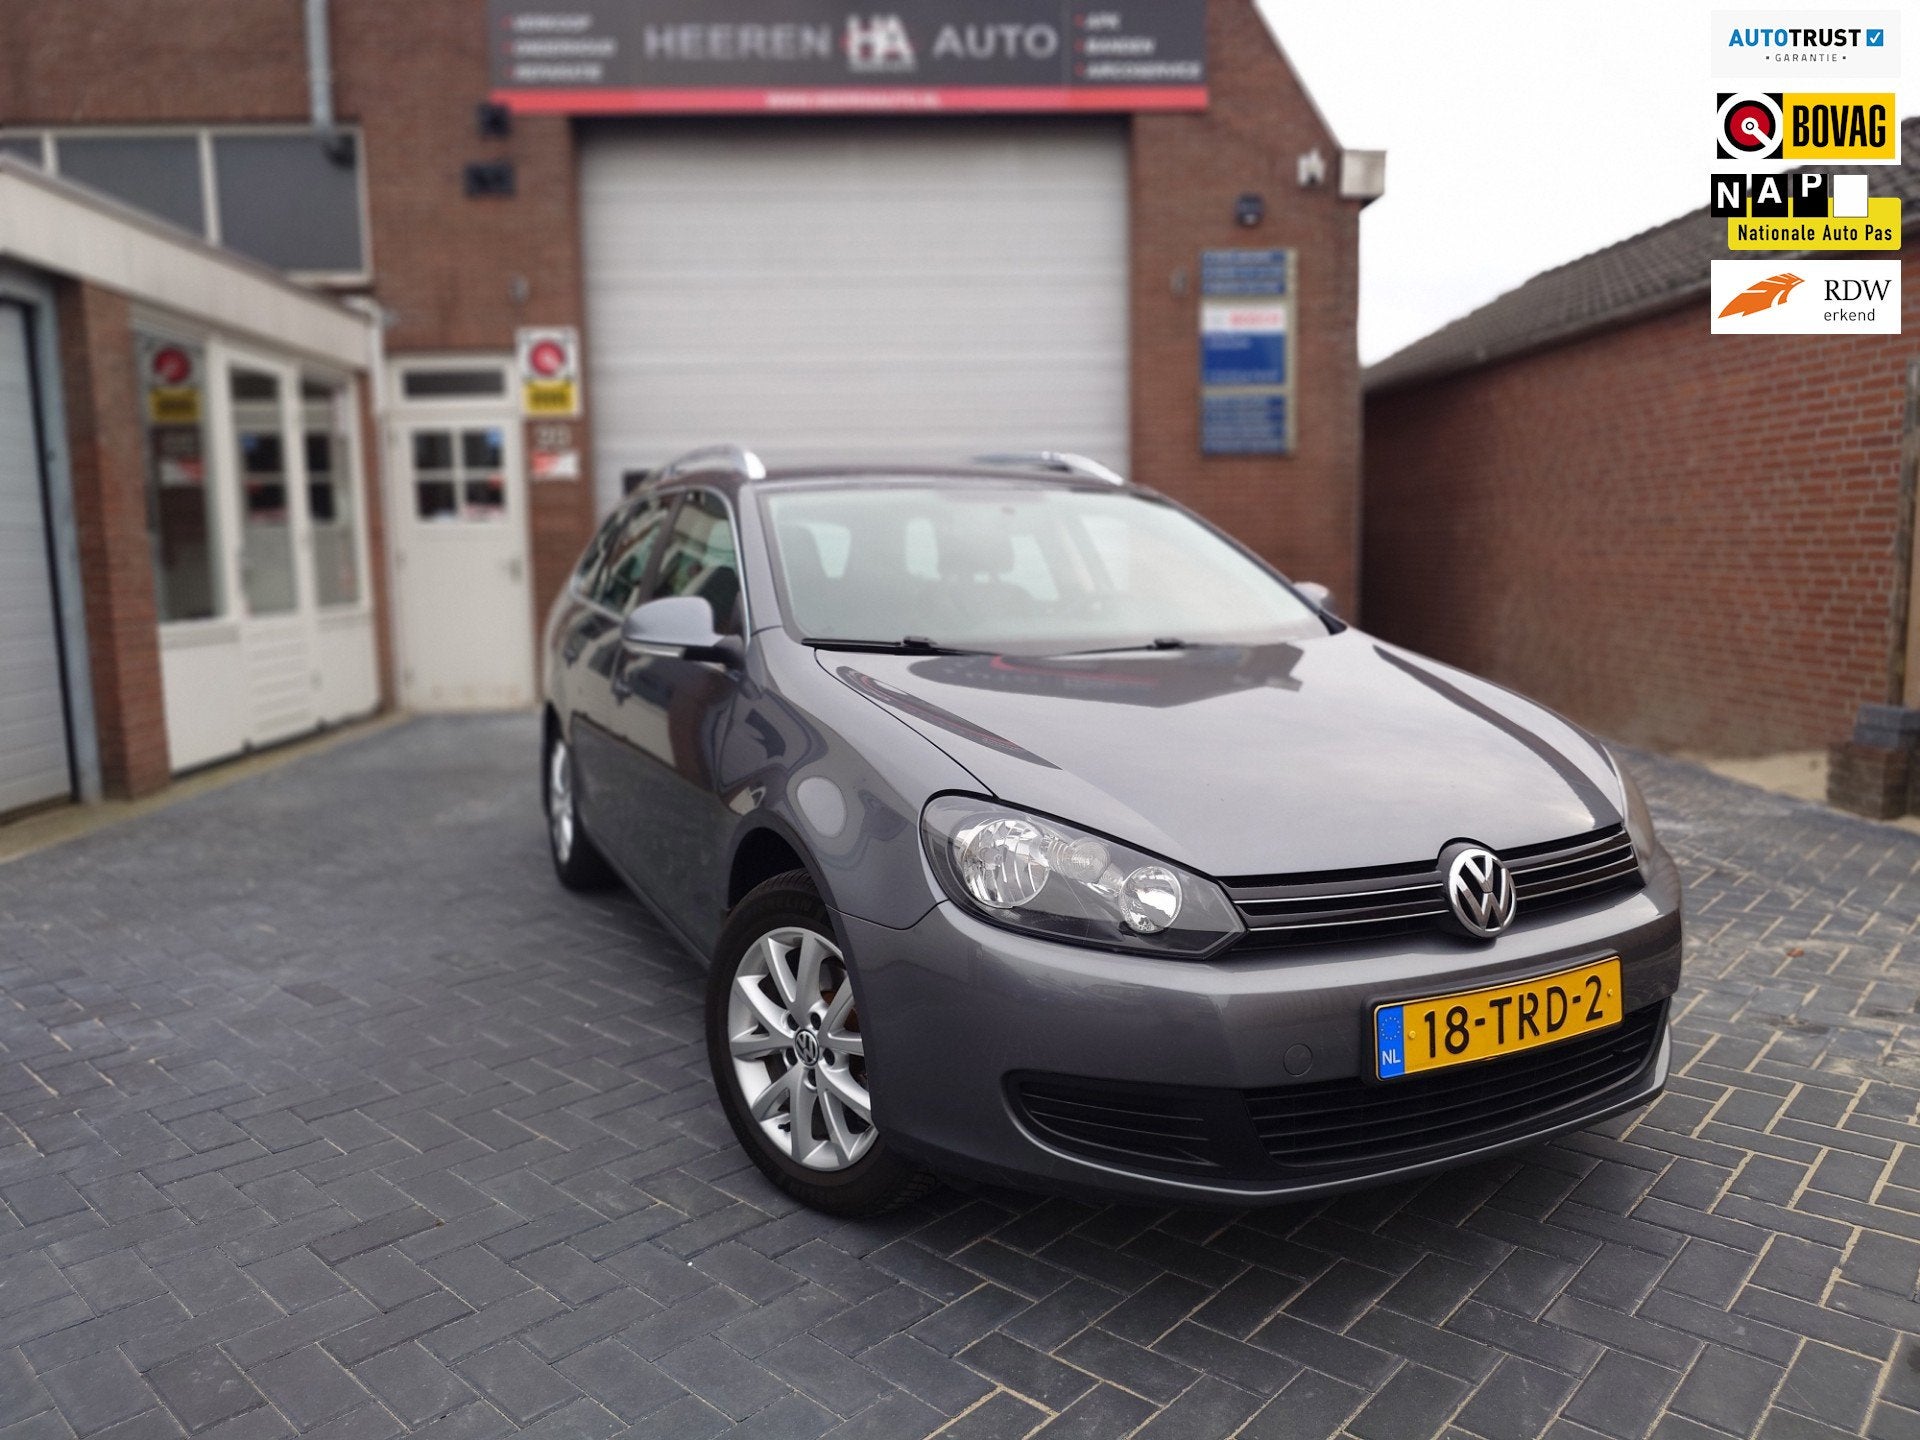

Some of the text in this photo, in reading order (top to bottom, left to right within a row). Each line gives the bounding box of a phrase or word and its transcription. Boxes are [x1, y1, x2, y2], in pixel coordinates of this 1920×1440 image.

[645, 24, 831, 60] HEEREN
[933, 24, 1058, 59] AUTO
[1424, 975, 1603, 1058] 18-TRD-2
[1382, 1048, 1401, 1065] NL
